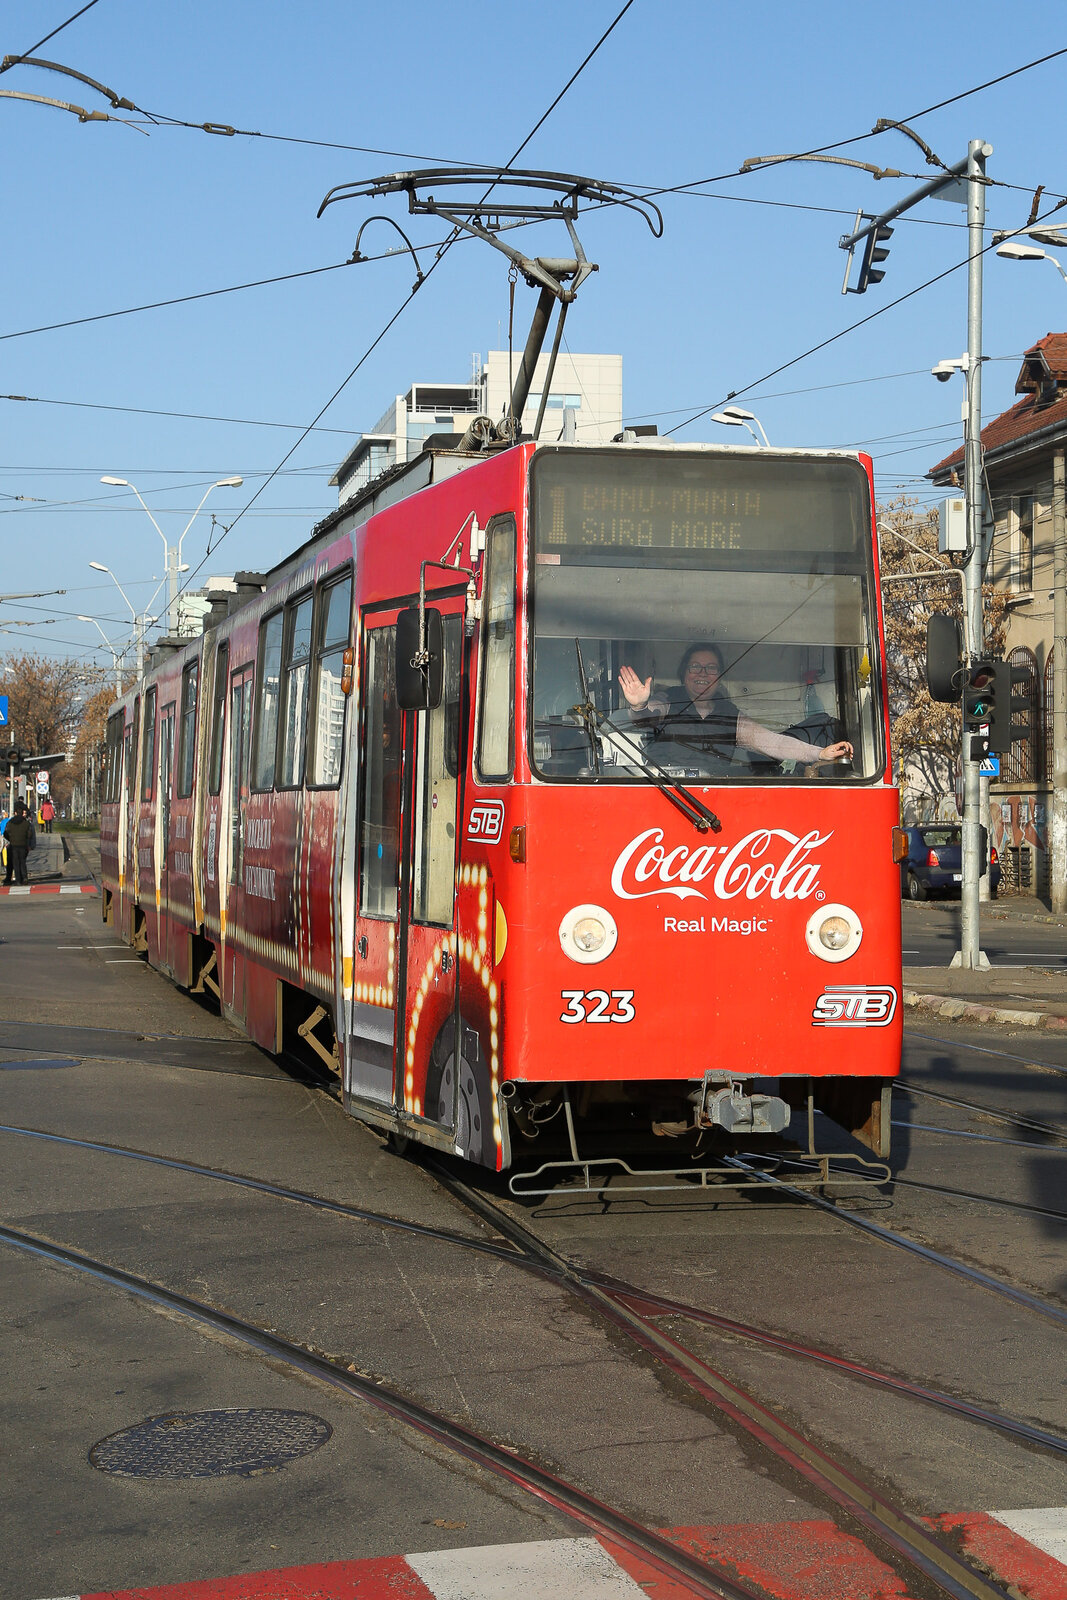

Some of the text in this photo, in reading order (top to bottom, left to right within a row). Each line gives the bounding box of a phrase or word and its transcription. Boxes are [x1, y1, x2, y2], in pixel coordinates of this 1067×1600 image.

[549, 486, 567, 544] 1
[582, 517, 741, 549] SURA MARE
[664, 917, 706, 933] Real
[560, 989, 635, 1024] 323
[813, 993, 892, 1019] STB
